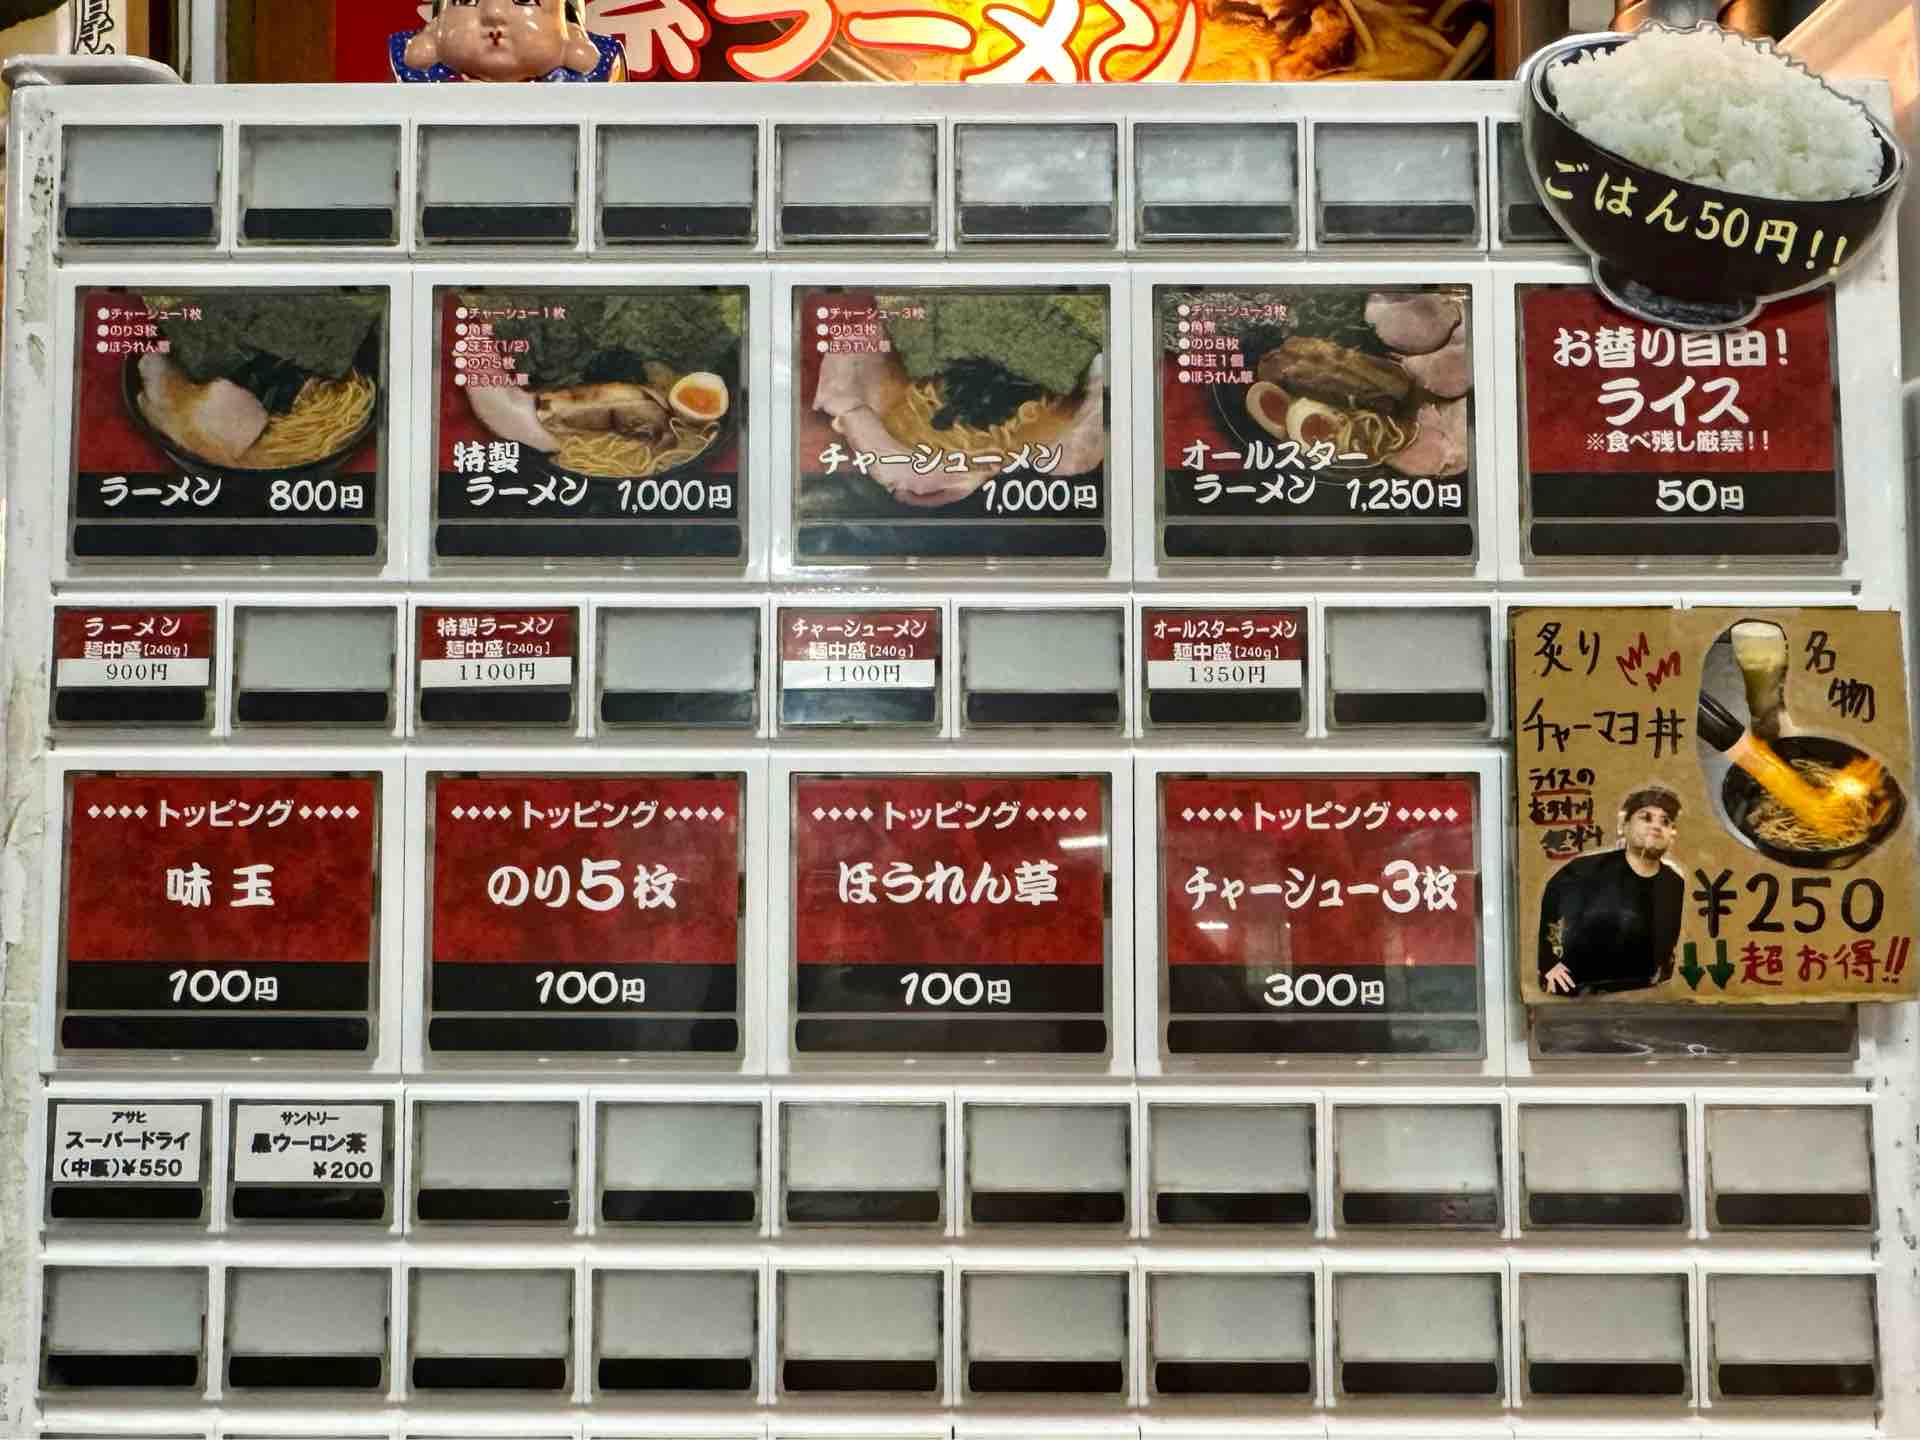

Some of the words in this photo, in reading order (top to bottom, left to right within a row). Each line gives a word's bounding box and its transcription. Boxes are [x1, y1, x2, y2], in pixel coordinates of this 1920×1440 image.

[110, 324, 160, 337] のり3枚
[1597, 375, 1750, 427] ライス
[453, 441, 520, 474] 特製
[818, 443, 1063, 475] チャーシューメン
[1182, 439, 1369, 471] オールスター
[100, 476, 222, 507] ラーメン
[269, 479, 364, 511] 800円
[466, 476, 588, 506] ラーメン
[616, 479, 733, 514] 1,000円
[982, 479, 1098, 514] 1,000円
[1193, 474, 1317, 504] ラーメン
[1346, 478, 1463, 512] 1,250円
[1656, 479, 1745, 512] 50円
[84, 617, 181, 637] ラーメン
[436, 616, 554, 637] 特製ラーメン
[791, 618, 927, 639] チャーシューメン
[1153, 620, 1298, 639] オールスターラーメン
[105, 662, 169, 682] 900円
[459, 662, 536, 681] 1100円
[824, 664, 901, 682] 1100円
[1188, 665, 1266, 683] 1350円
[1534, 621, 1601, 678] 炙り
[1804, 631, 1876, 723] 名物
[1528, 767, 1596, 790] ライスの
[159, 799, 294, 828] トッピング
[523, 800, 660, 829] トッピング
[885, 801, 1022, 831] トッピング
[1254, 801, 1392, 831] トッピング
[166, 862, 275, 908] 味玉
[487, 858, 679, 912] のり5枚
[838, 859, 1059, 906] ほうれん草
[1185, 860, 1459, 914] チャーシュー3枚
[1692, 868, 1885, 939] ¥250
[168, 969, 279, 1003] 100円
[535, 971, 647, 1005] 100円
[900, 972, 1012, 1007] 100円
[1263, 973, 1386, 1008] 300円
[111, 1110, 148, 1124] アサヒ
[280, 1111, 341, 1126] サントリー
[66, 1131, 192, 1151] スーパードライ
[312, 1160, 374, 1179] ¥200
